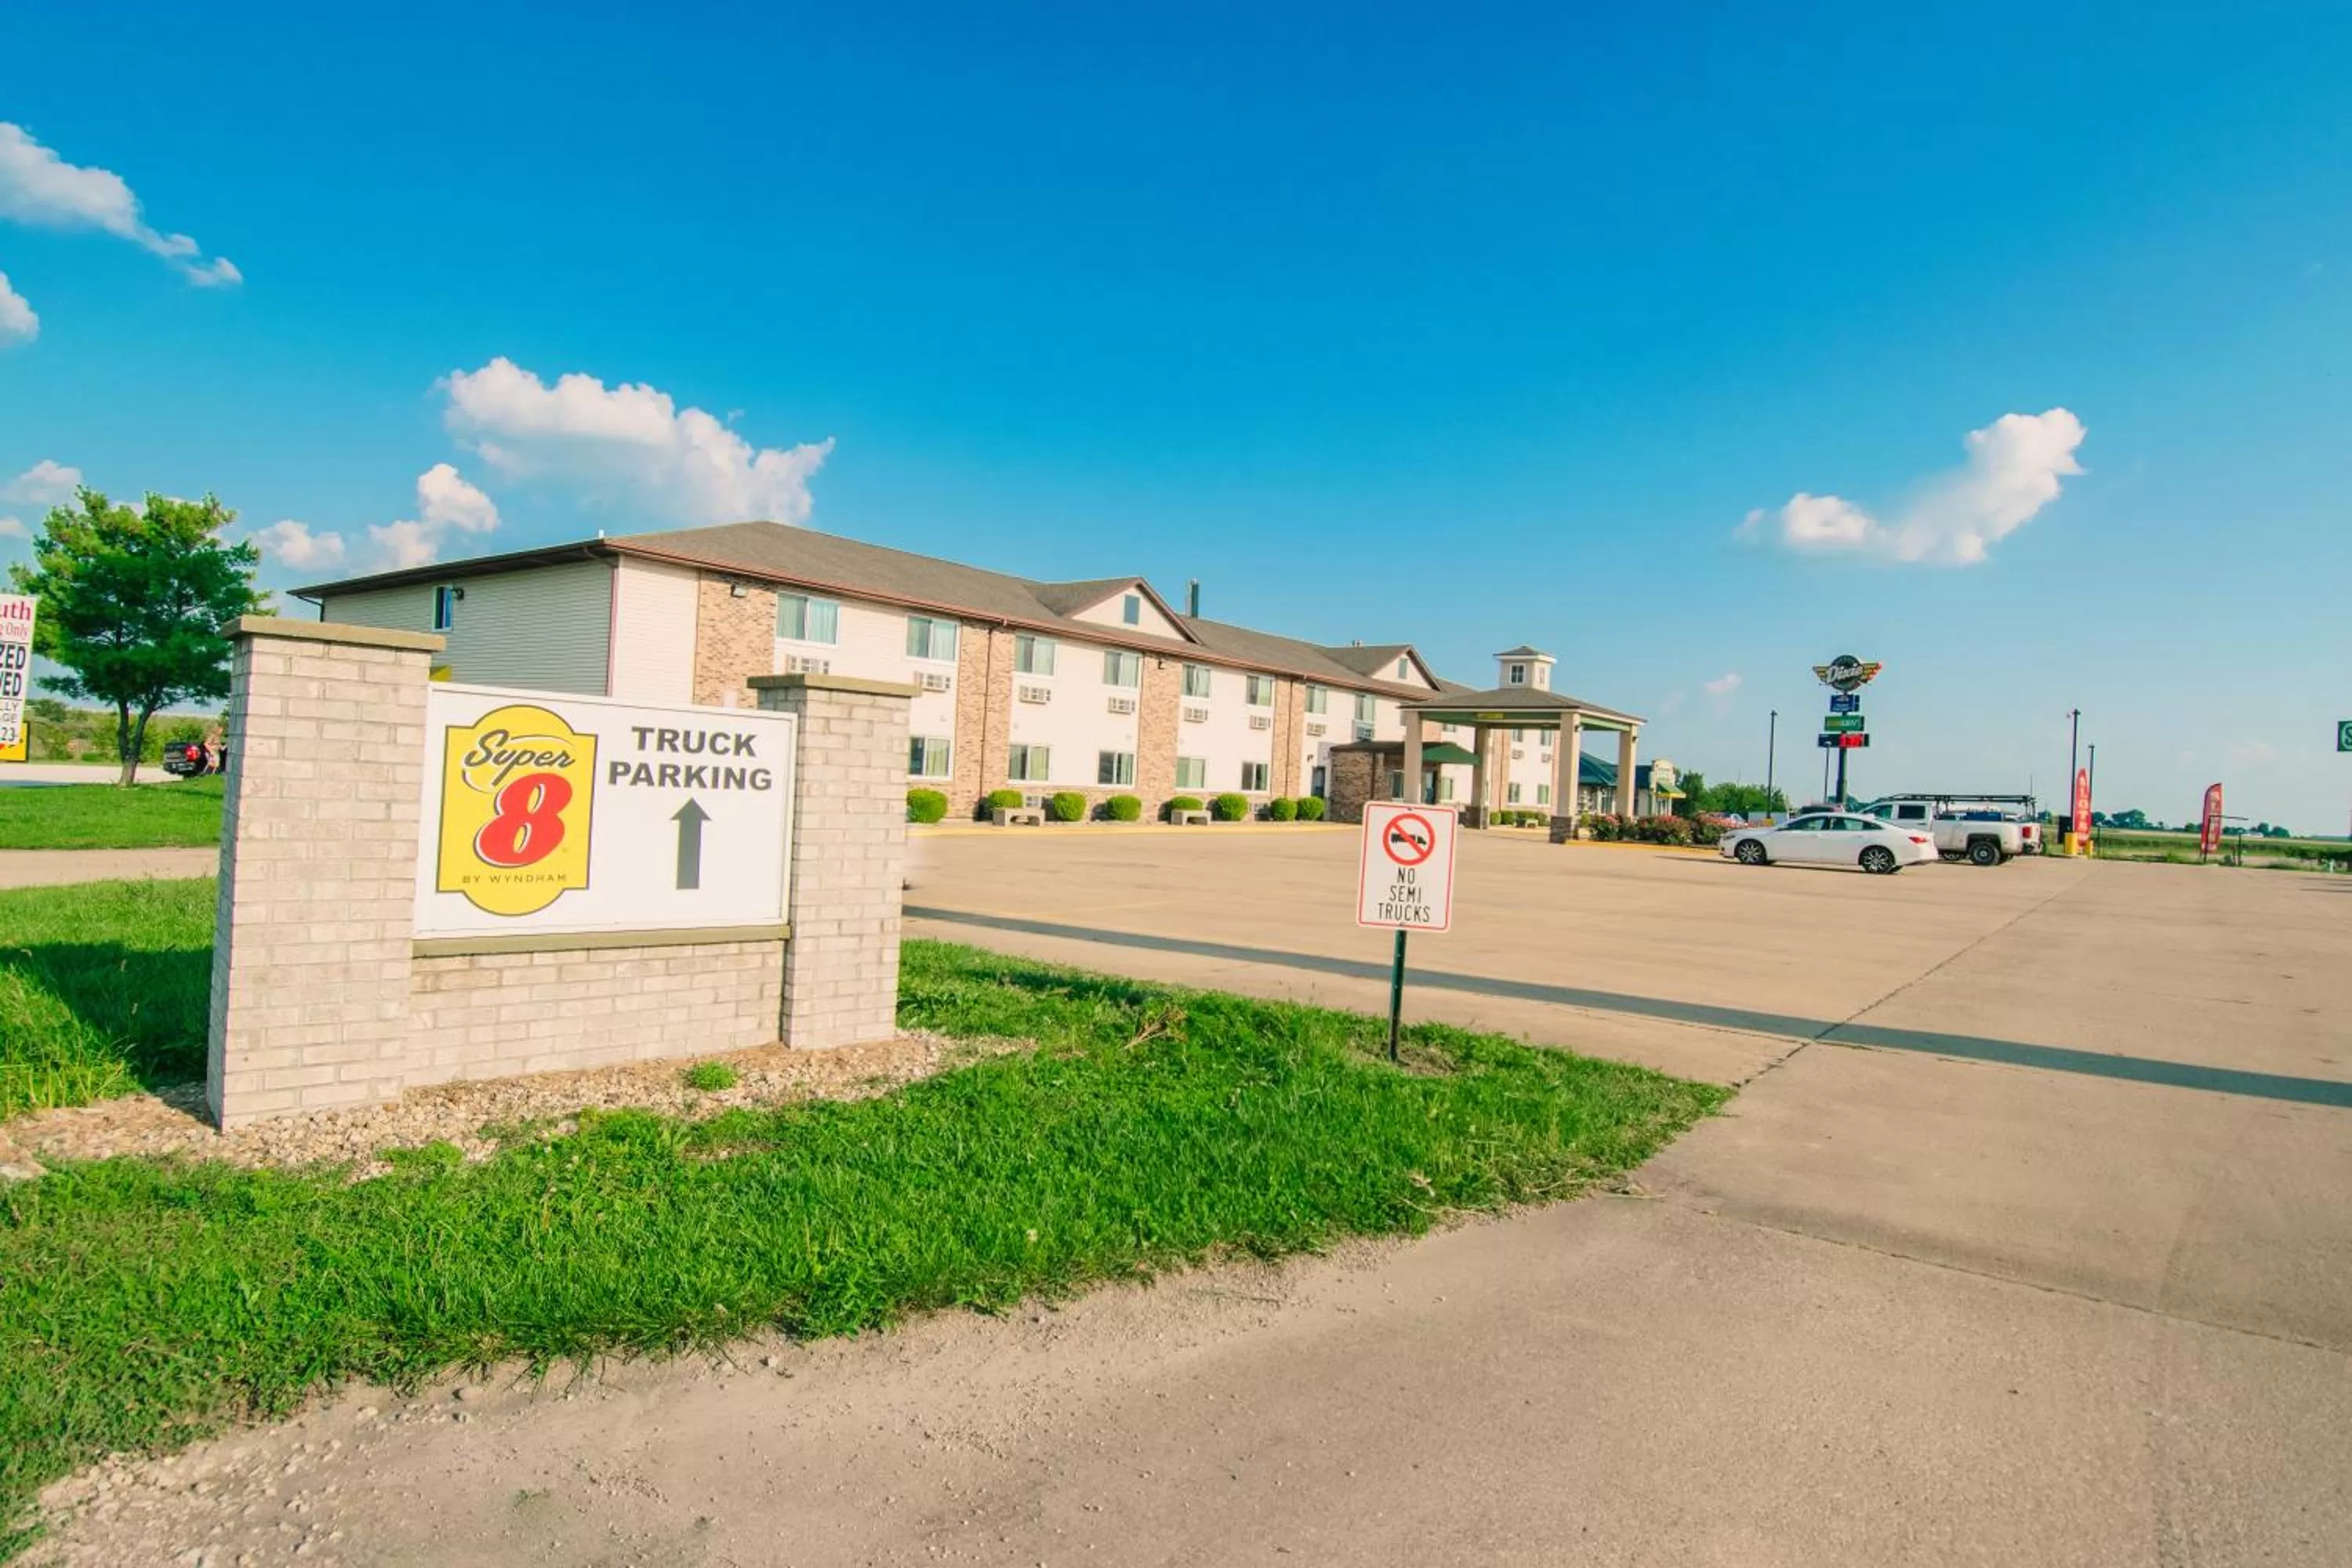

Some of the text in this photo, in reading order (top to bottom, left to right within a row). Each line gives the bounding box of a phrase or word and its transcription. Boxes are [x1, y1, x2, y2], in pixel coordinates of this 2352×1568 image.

[0, 671, 21, 696] ED
[630, 726, 757, 757] TRUCK
[463, 728, 576, 788] Super
[608, 761, 773, 791] PARKING
[473, 771, 574, 869] 8
[461, 873, 568, 884] BY WYNDHAM
[1396, 867, 1416, 884] NO
[1389, 884, 1422, 904] SEMI
[1377, 902, 1432, 924] TRUCKS
